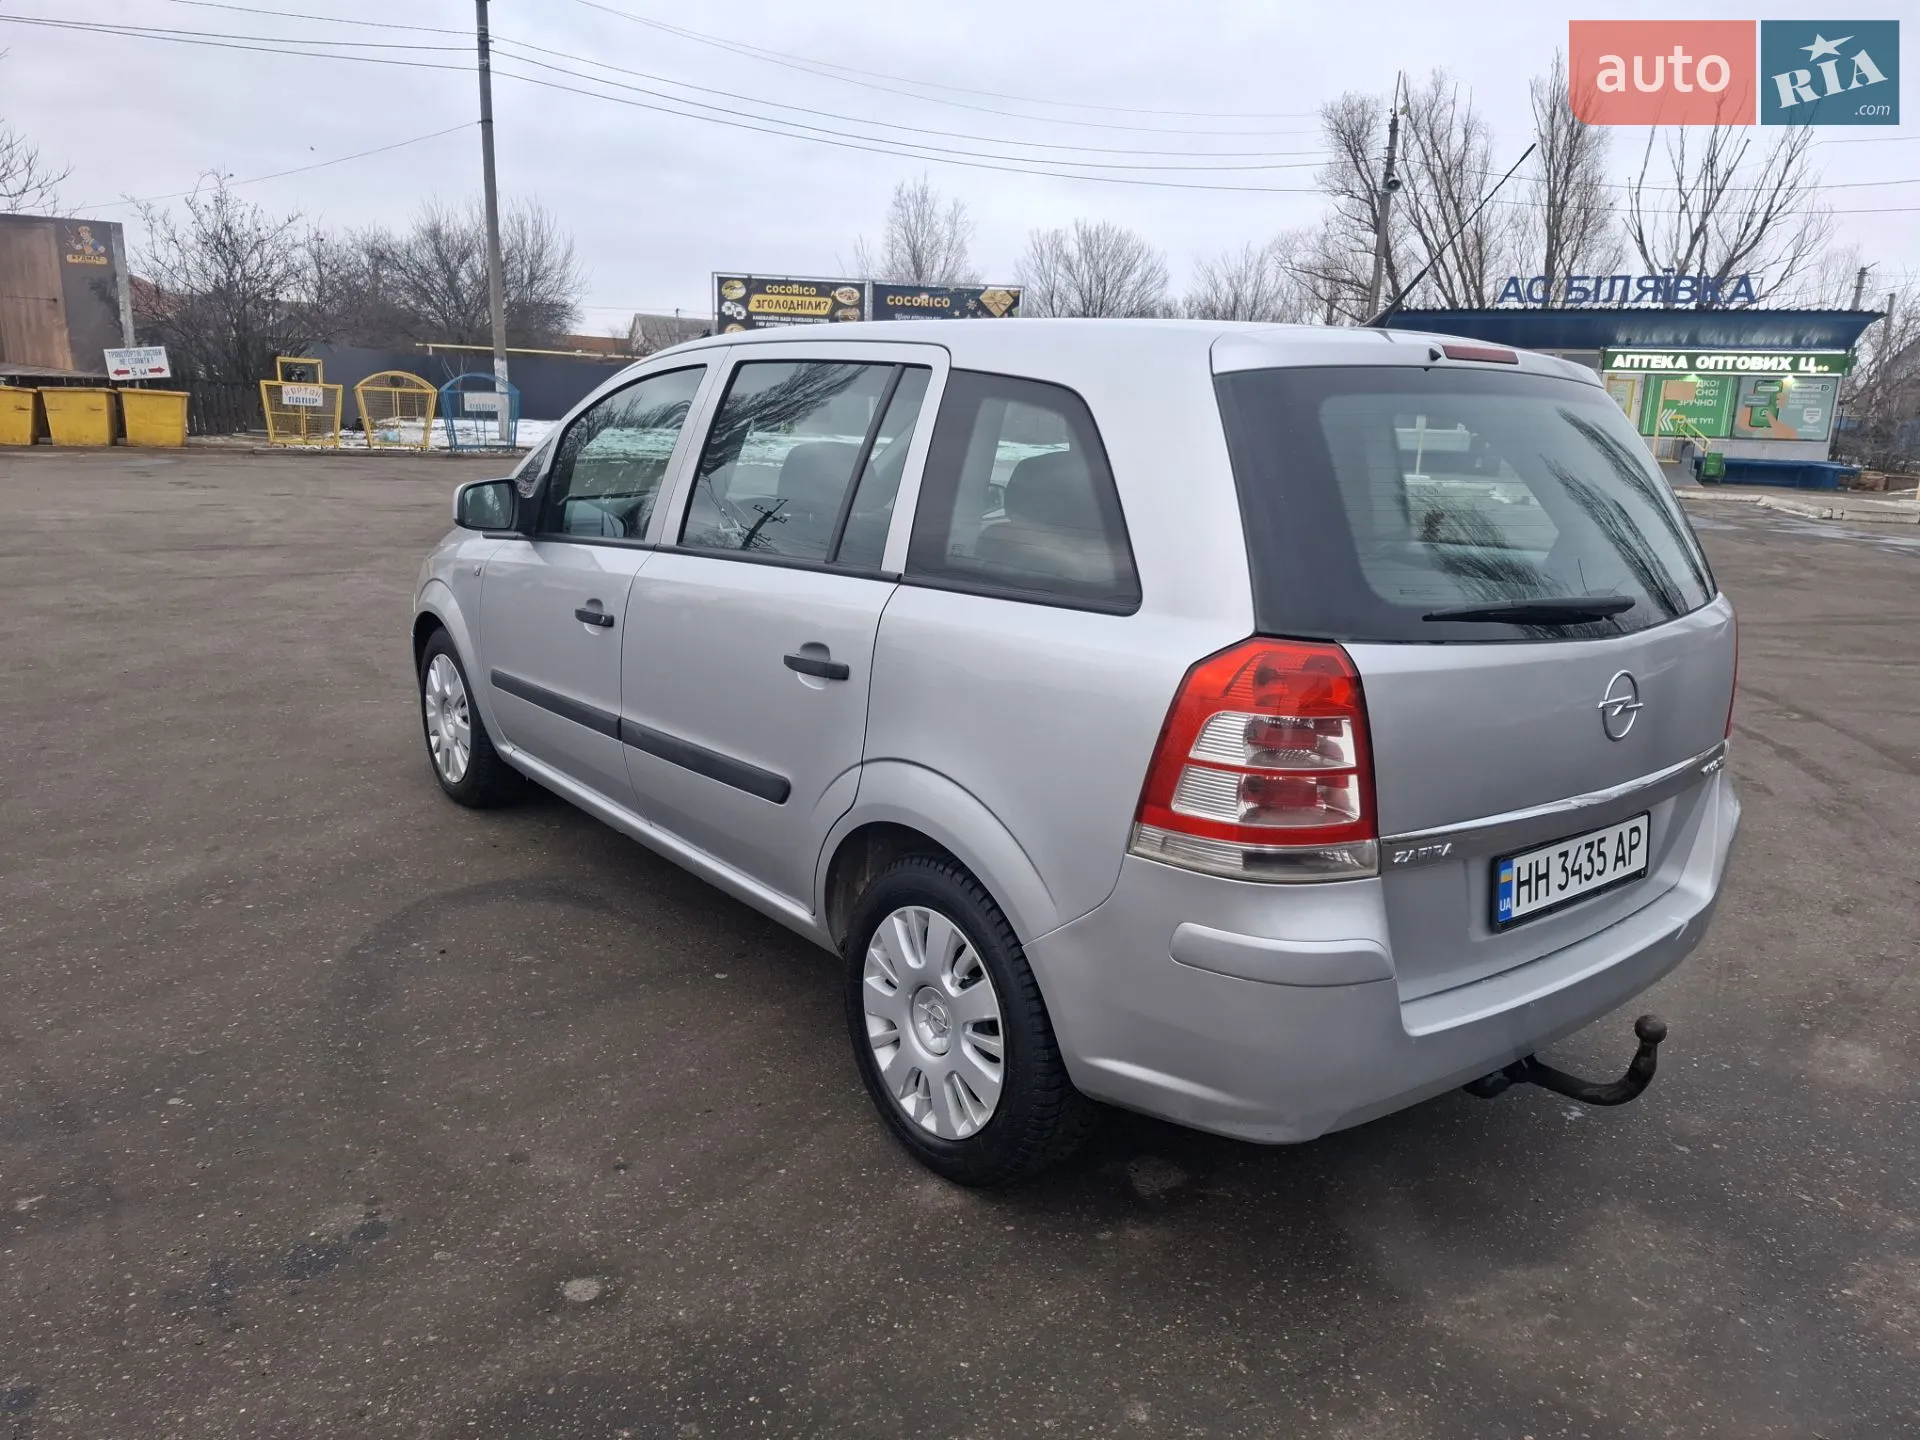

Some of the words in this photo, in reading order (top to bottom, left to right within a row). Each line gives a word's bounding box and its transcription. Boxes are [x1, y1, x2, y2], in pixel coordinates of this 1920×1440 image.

[765, 284, 817, 295] COCORICO
[1497, 276, 1550, 304] АС
[1563, 268, 1757, 304] БІЛЯЇВКА
[755, 299, 828, 311] ЗГОЛОДНІЛИ?
[886, 294, 951, 308] COCORICO
[1612, 354, 1689, 370] АПТЕКА
[1696, 356, 1792, 372] ОПТОВИХ
[130, 367, 137, 376] 5
[1515, 856, 1550, 907] HH
[1556, 839, 1607, 891] 3435
[1612, 825, 1642, 873] AP
[1499, 897, 1512, 912] UA
